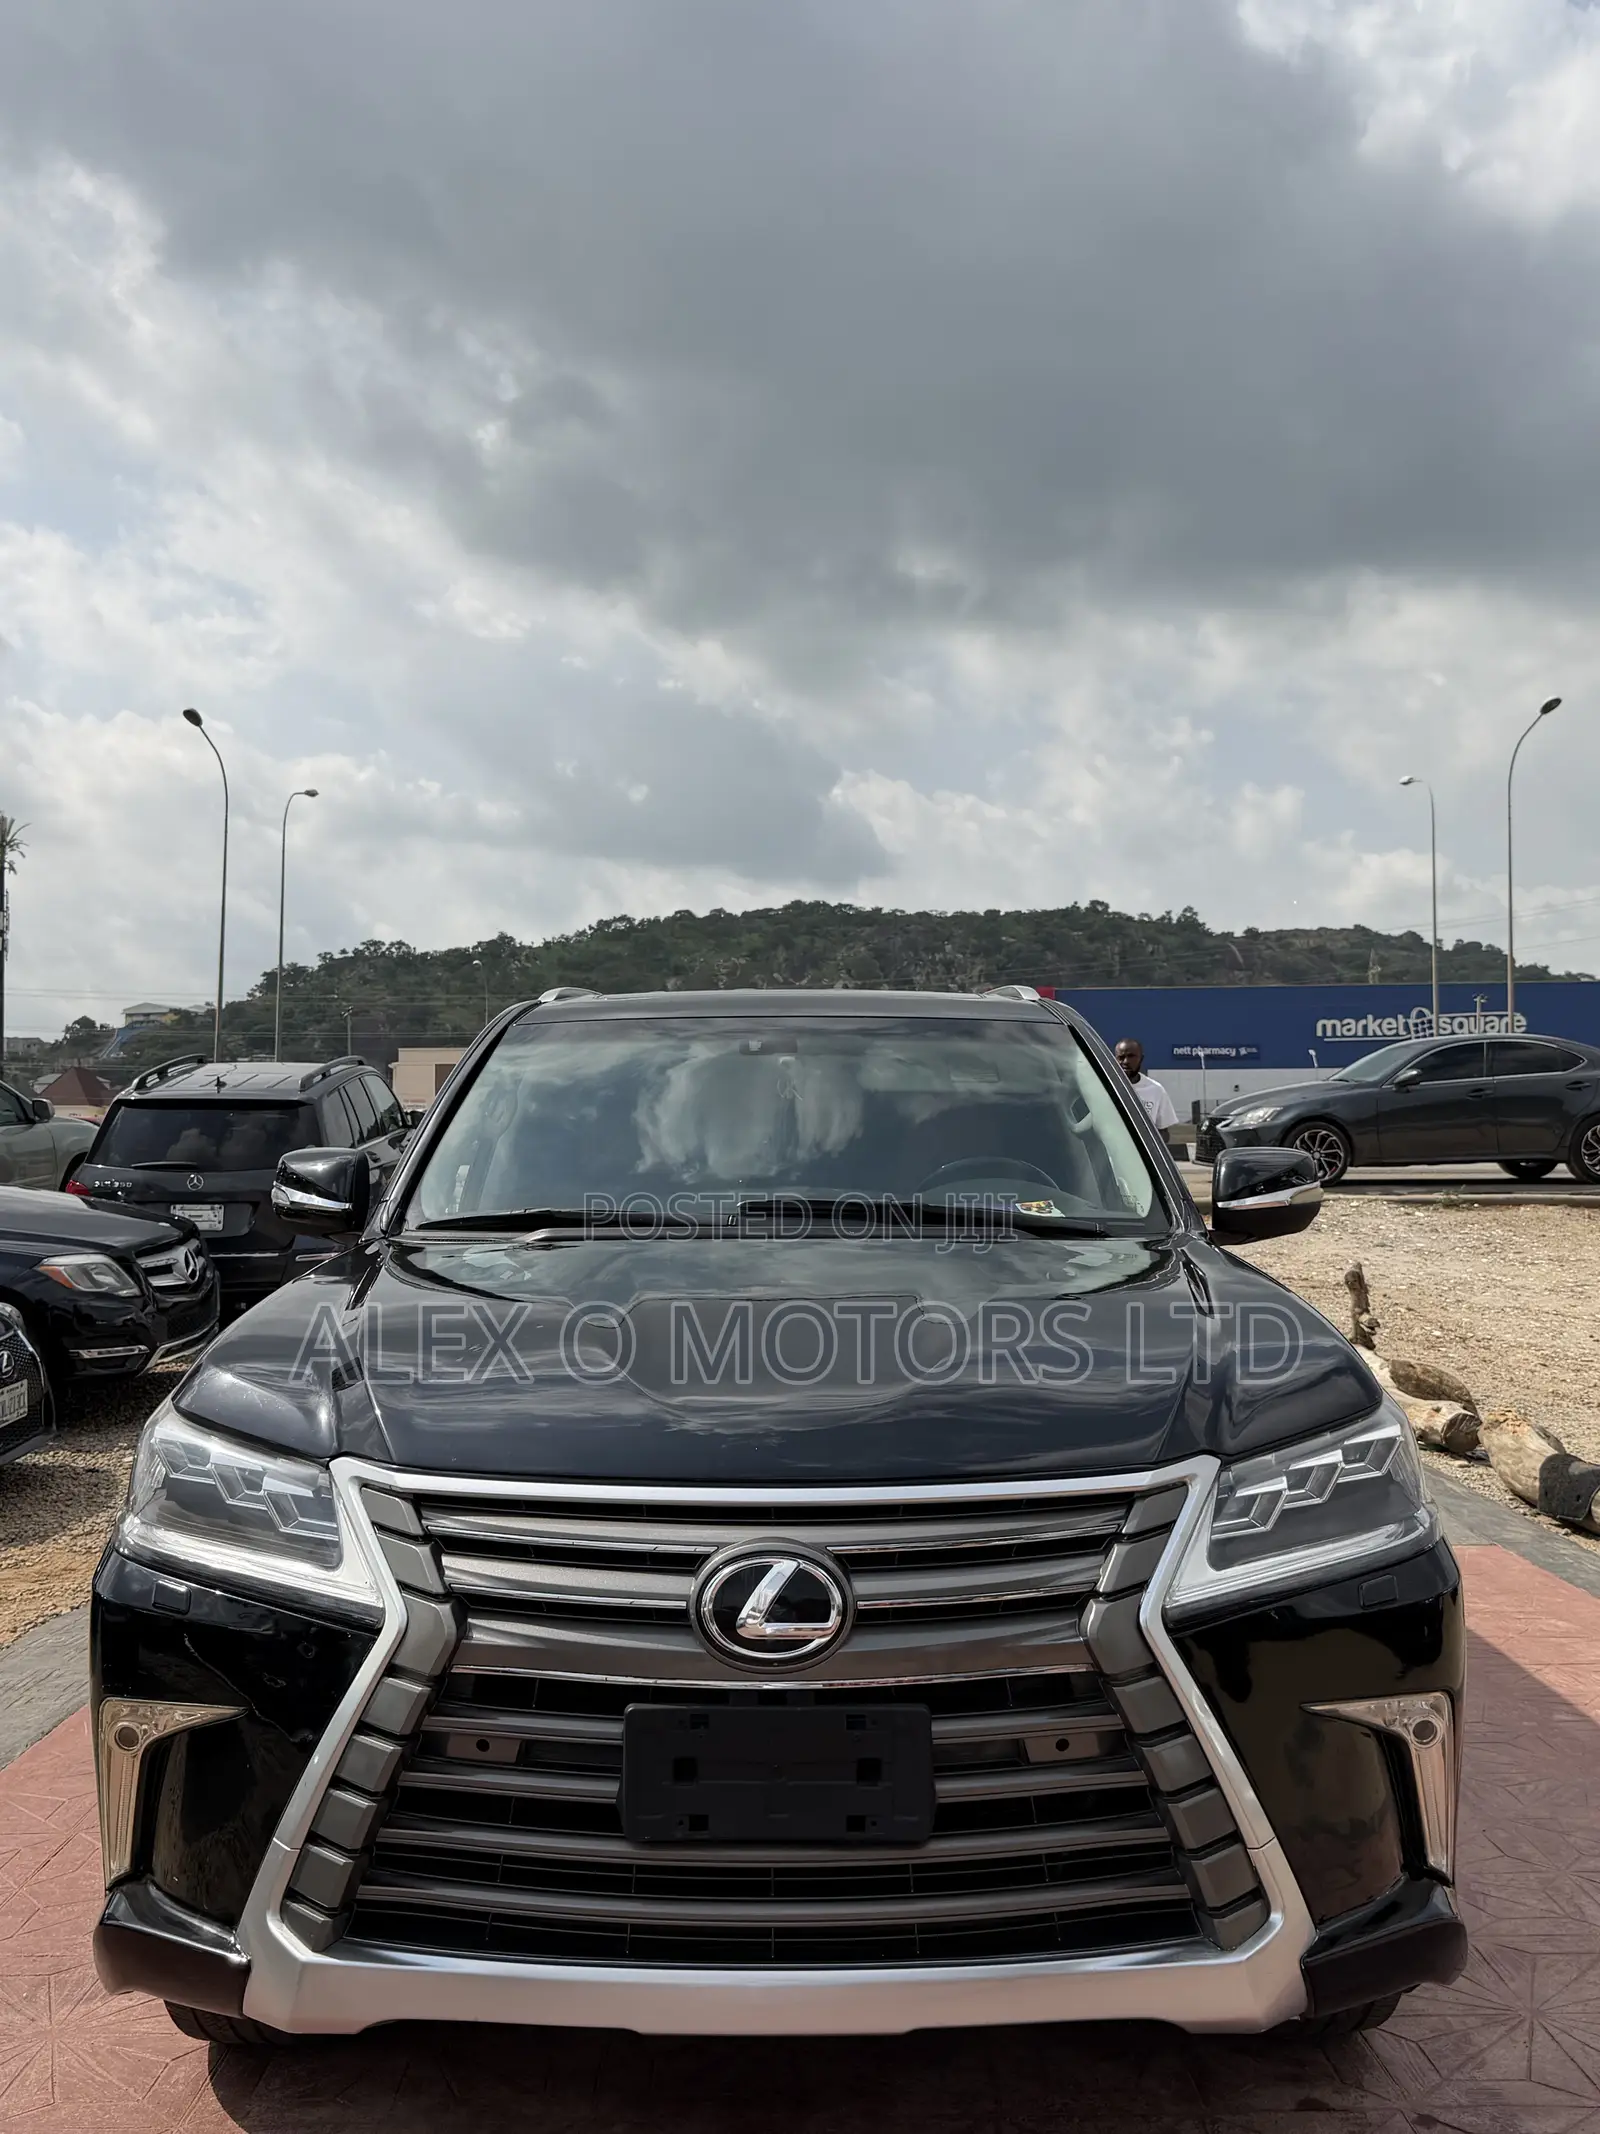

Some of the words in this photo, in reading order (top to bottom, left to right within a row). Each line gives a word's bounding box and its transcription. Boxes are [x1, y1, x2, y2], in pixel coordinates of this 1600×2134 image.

[1316, 1013, 1404, 1037] market
[1173, 1046, 1191, 1055] nett
[1192, 1045, 1236, 1057] pharmacy
